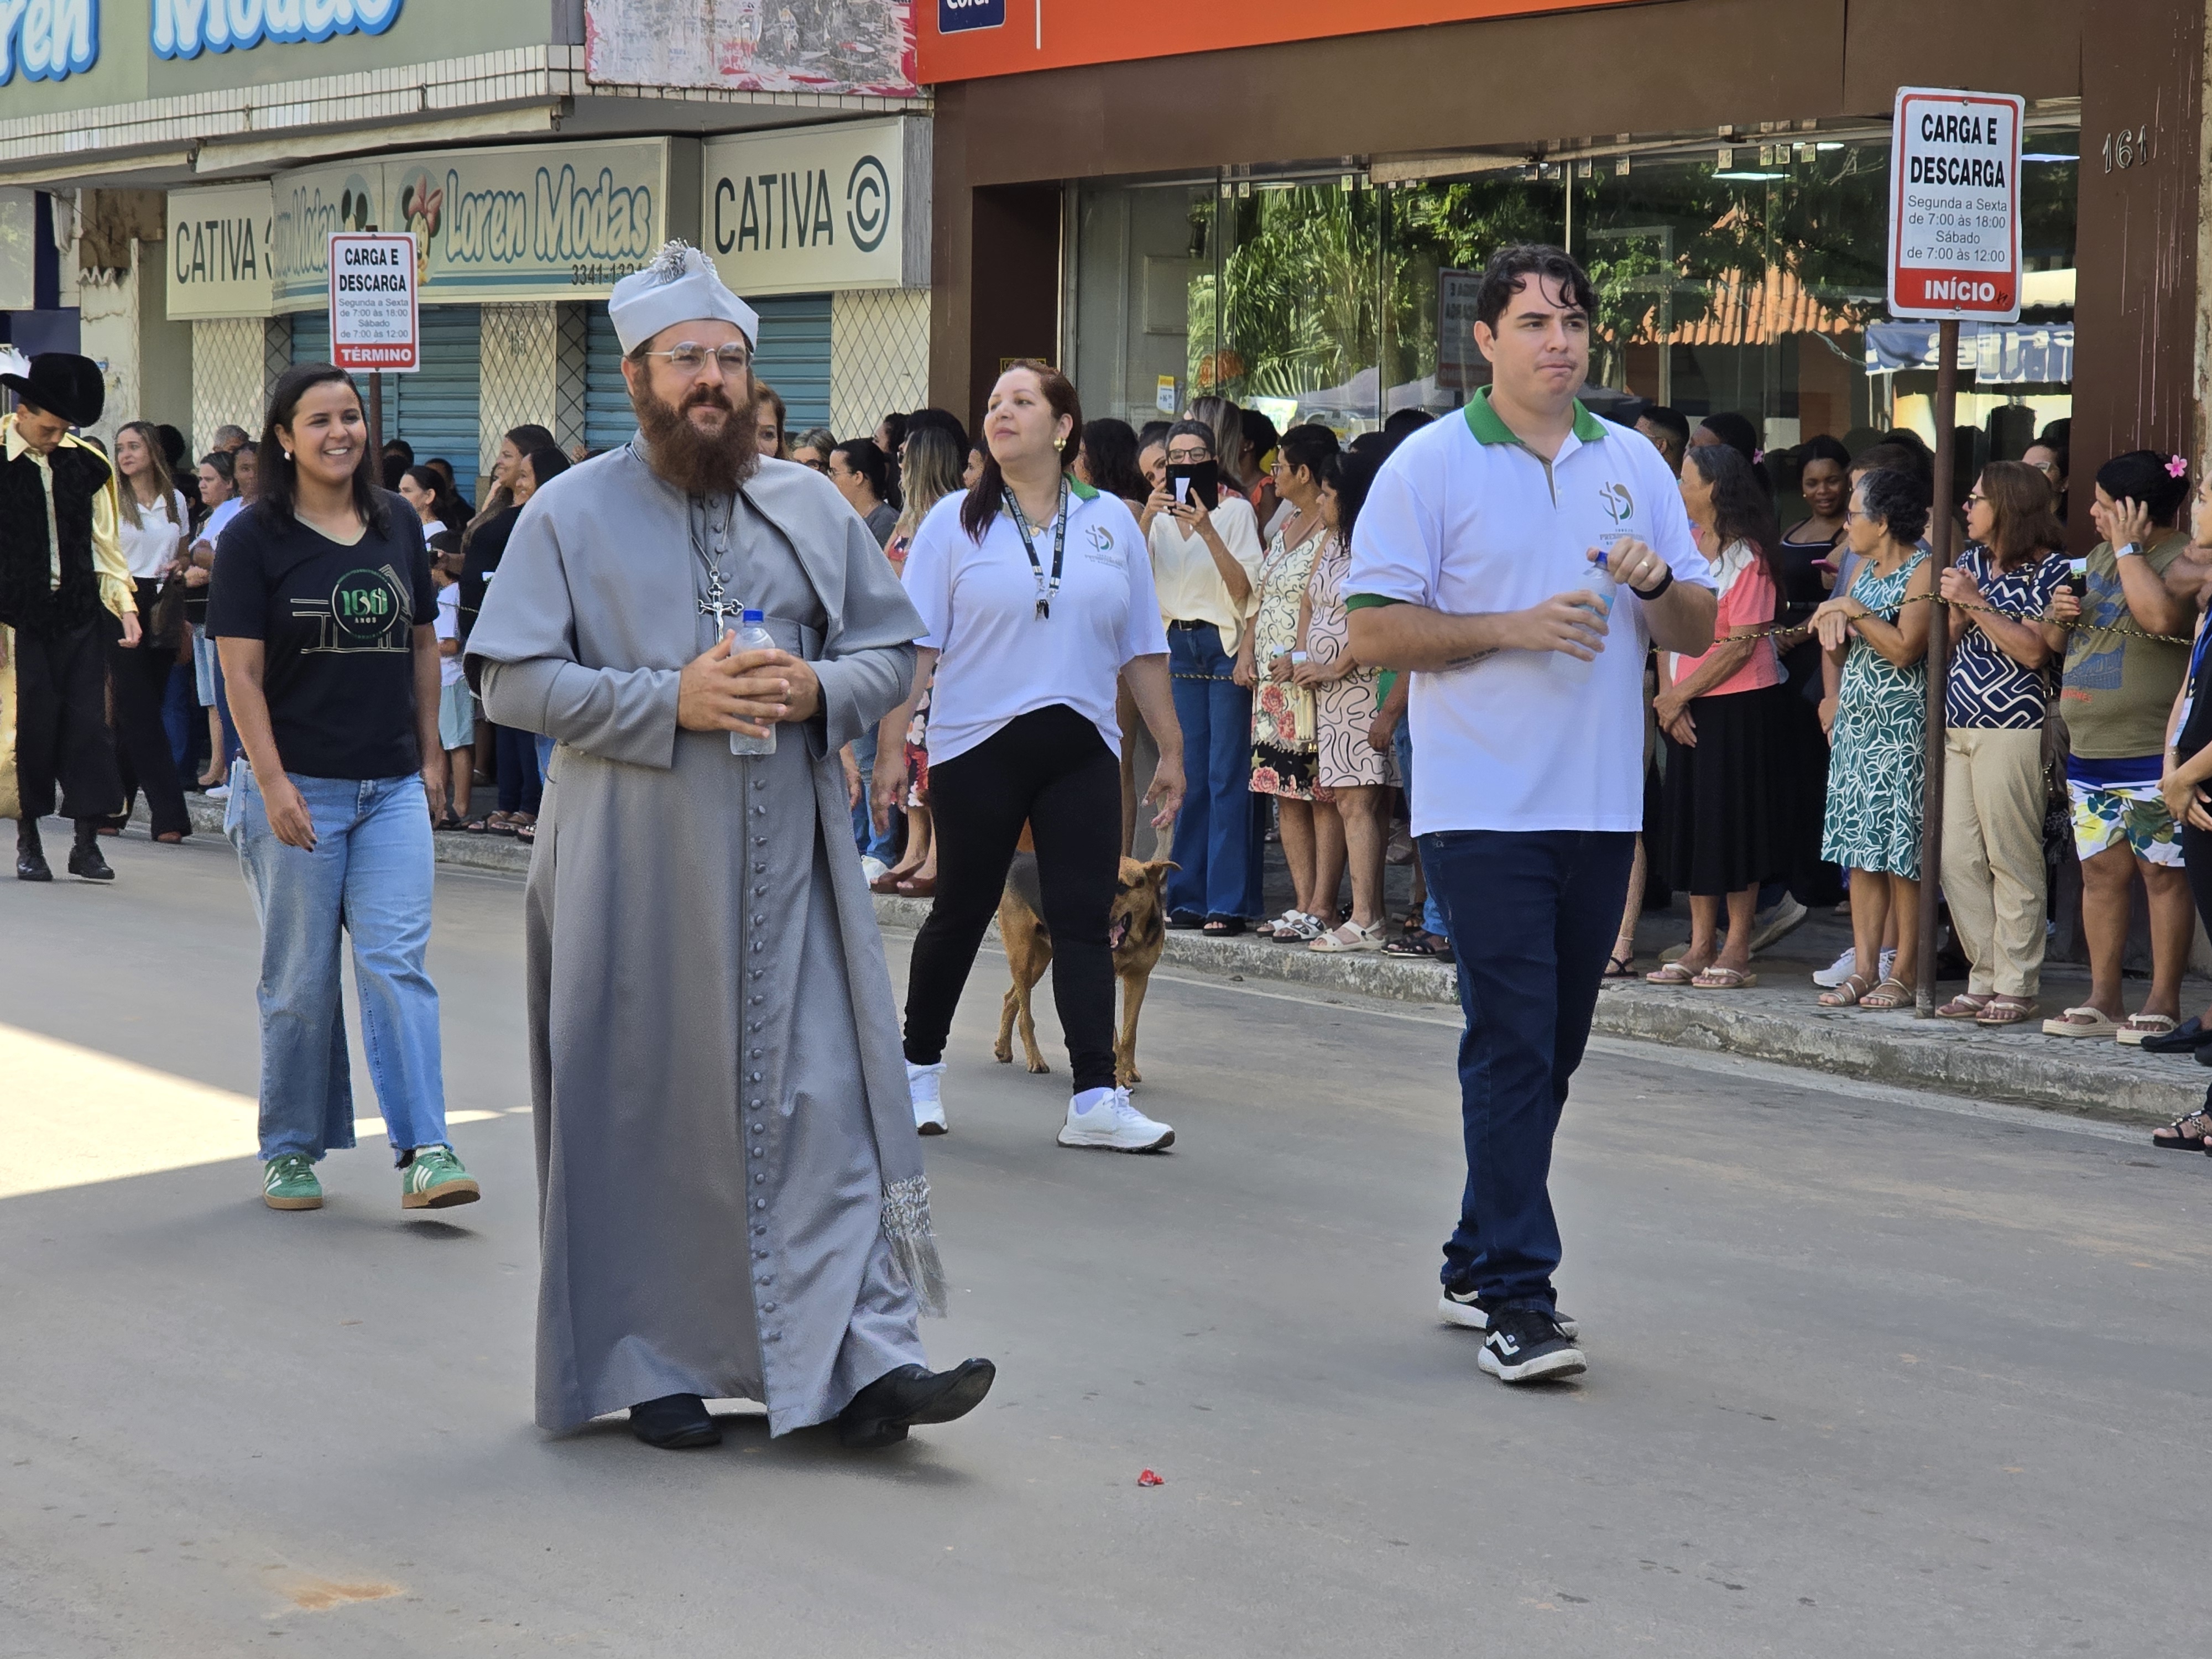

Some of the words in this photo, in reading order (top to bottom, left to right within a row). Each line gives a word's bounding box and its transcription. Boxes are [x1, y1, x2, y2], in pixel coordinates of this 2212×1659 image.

[1922, 113, 1982, 144] CARGA
[1987, 118, 1997, 145] E
[2103, 124, 2146, 174] 161
[1911, 156, 2005, 188] DESCARGA
[715, 169, 833, 254] CATIVA
[1908, 195, 1962, 211] Segunda
[1965, 200, 1973, 210] a
[1976, 198, 2007, 212] Sexta
[446, 168, 526, 264] Loren
[534, 164, 651, 263] Modas
[1908, 212, 1924, 225] de
[1928, 213, 1954, 226] 7:00
[1958, 215, 1971, 227] às
[1976, 215, 2006, 228] 18:00
[1936, 230, 1980, 244] Sábado
[176, 218, 257, 284] CATIVA
[345, 248, 387, 266] CARGA
[391, 248, 399, 265] E
[1907, 247, 1922, 259] de
[1927, 247, 1953, 260] 7:00
[1957, 248, 1970, 261] às
[1974, 249, 2005, 262] 12:00
[339, 274, 407, 291] DESCARGA
[1925, 276, 1995, 302] INÍCIO
[338, 299, 375, 308] Segunda
[358, 319, 390, 327] Sábado
[341, 346, 411, 362] TÉRMINO
[341, 587, 388, 616] 100
